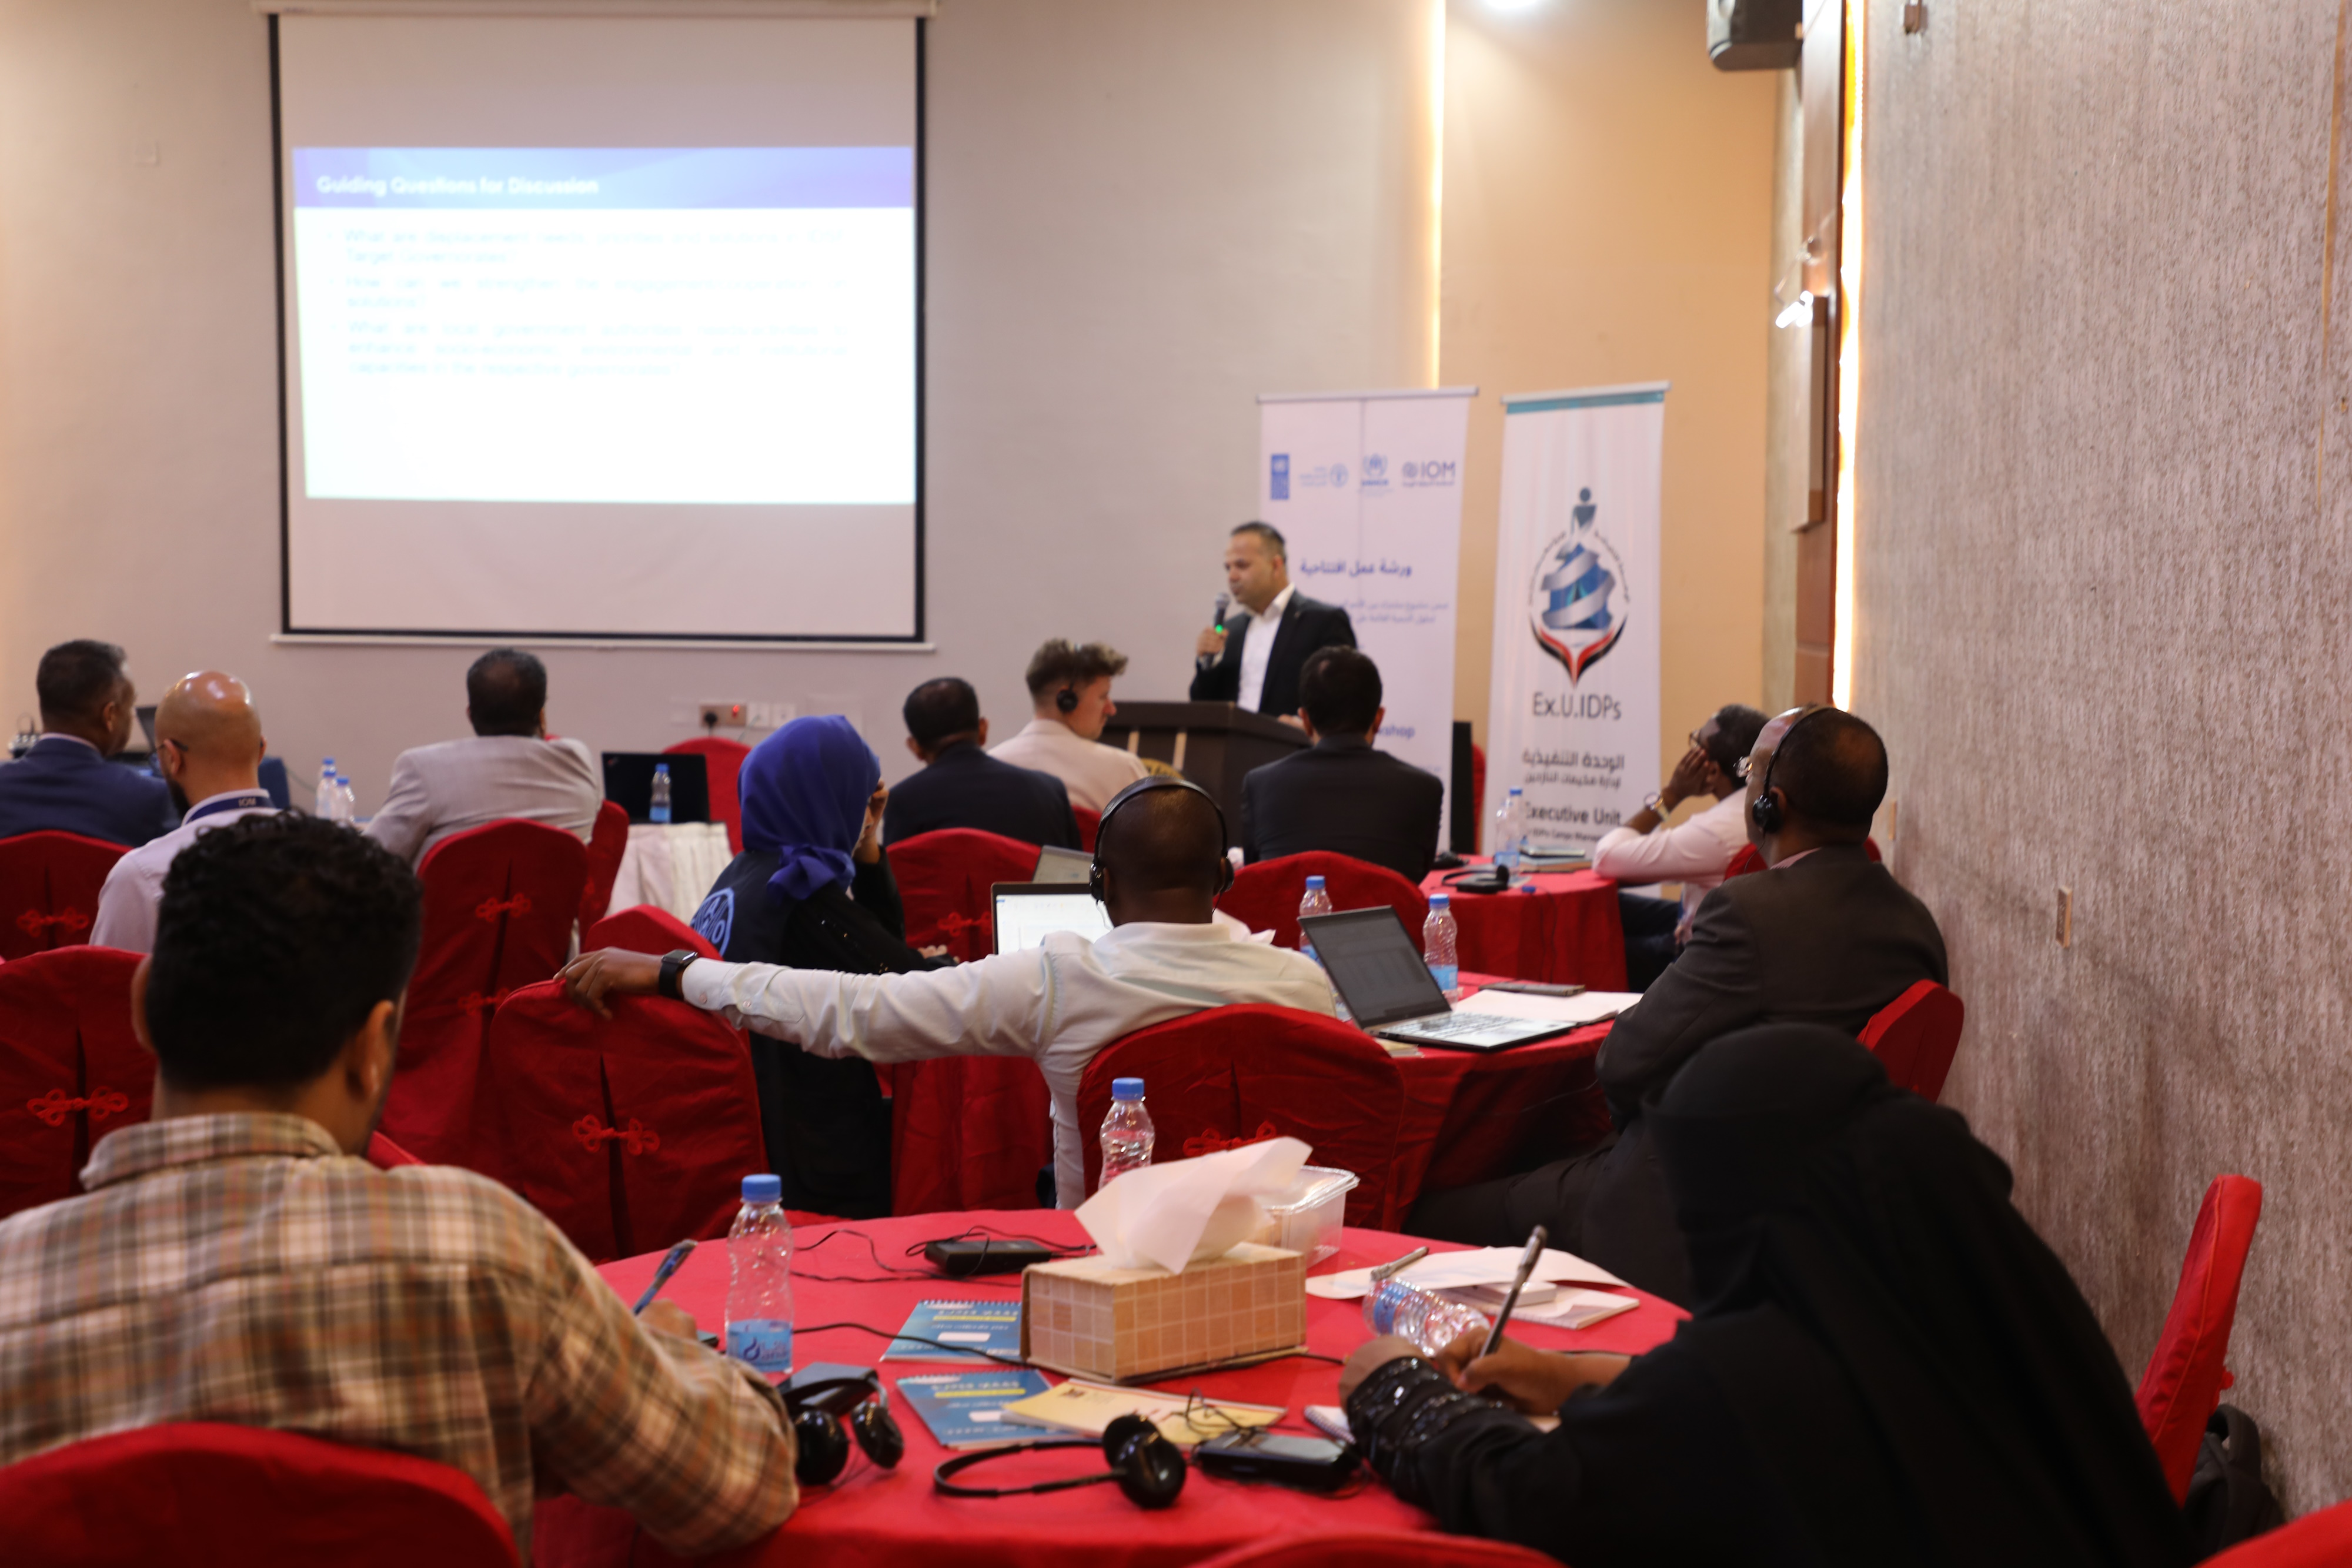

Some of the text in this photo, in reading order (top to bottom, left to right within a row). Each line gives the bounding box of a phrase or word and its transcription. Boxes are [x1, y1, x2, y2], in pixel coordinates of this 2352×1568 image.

[317, 176, 599, 196] Guiding Questions for Discussion
[1421, 461, 1456, 479] IOM
[1532, 692, 1622, 721] Ex.U.IDPs
[1582, 752, 1625, 773] الوحدة
[1593, 807, 1621, 825] Unit
